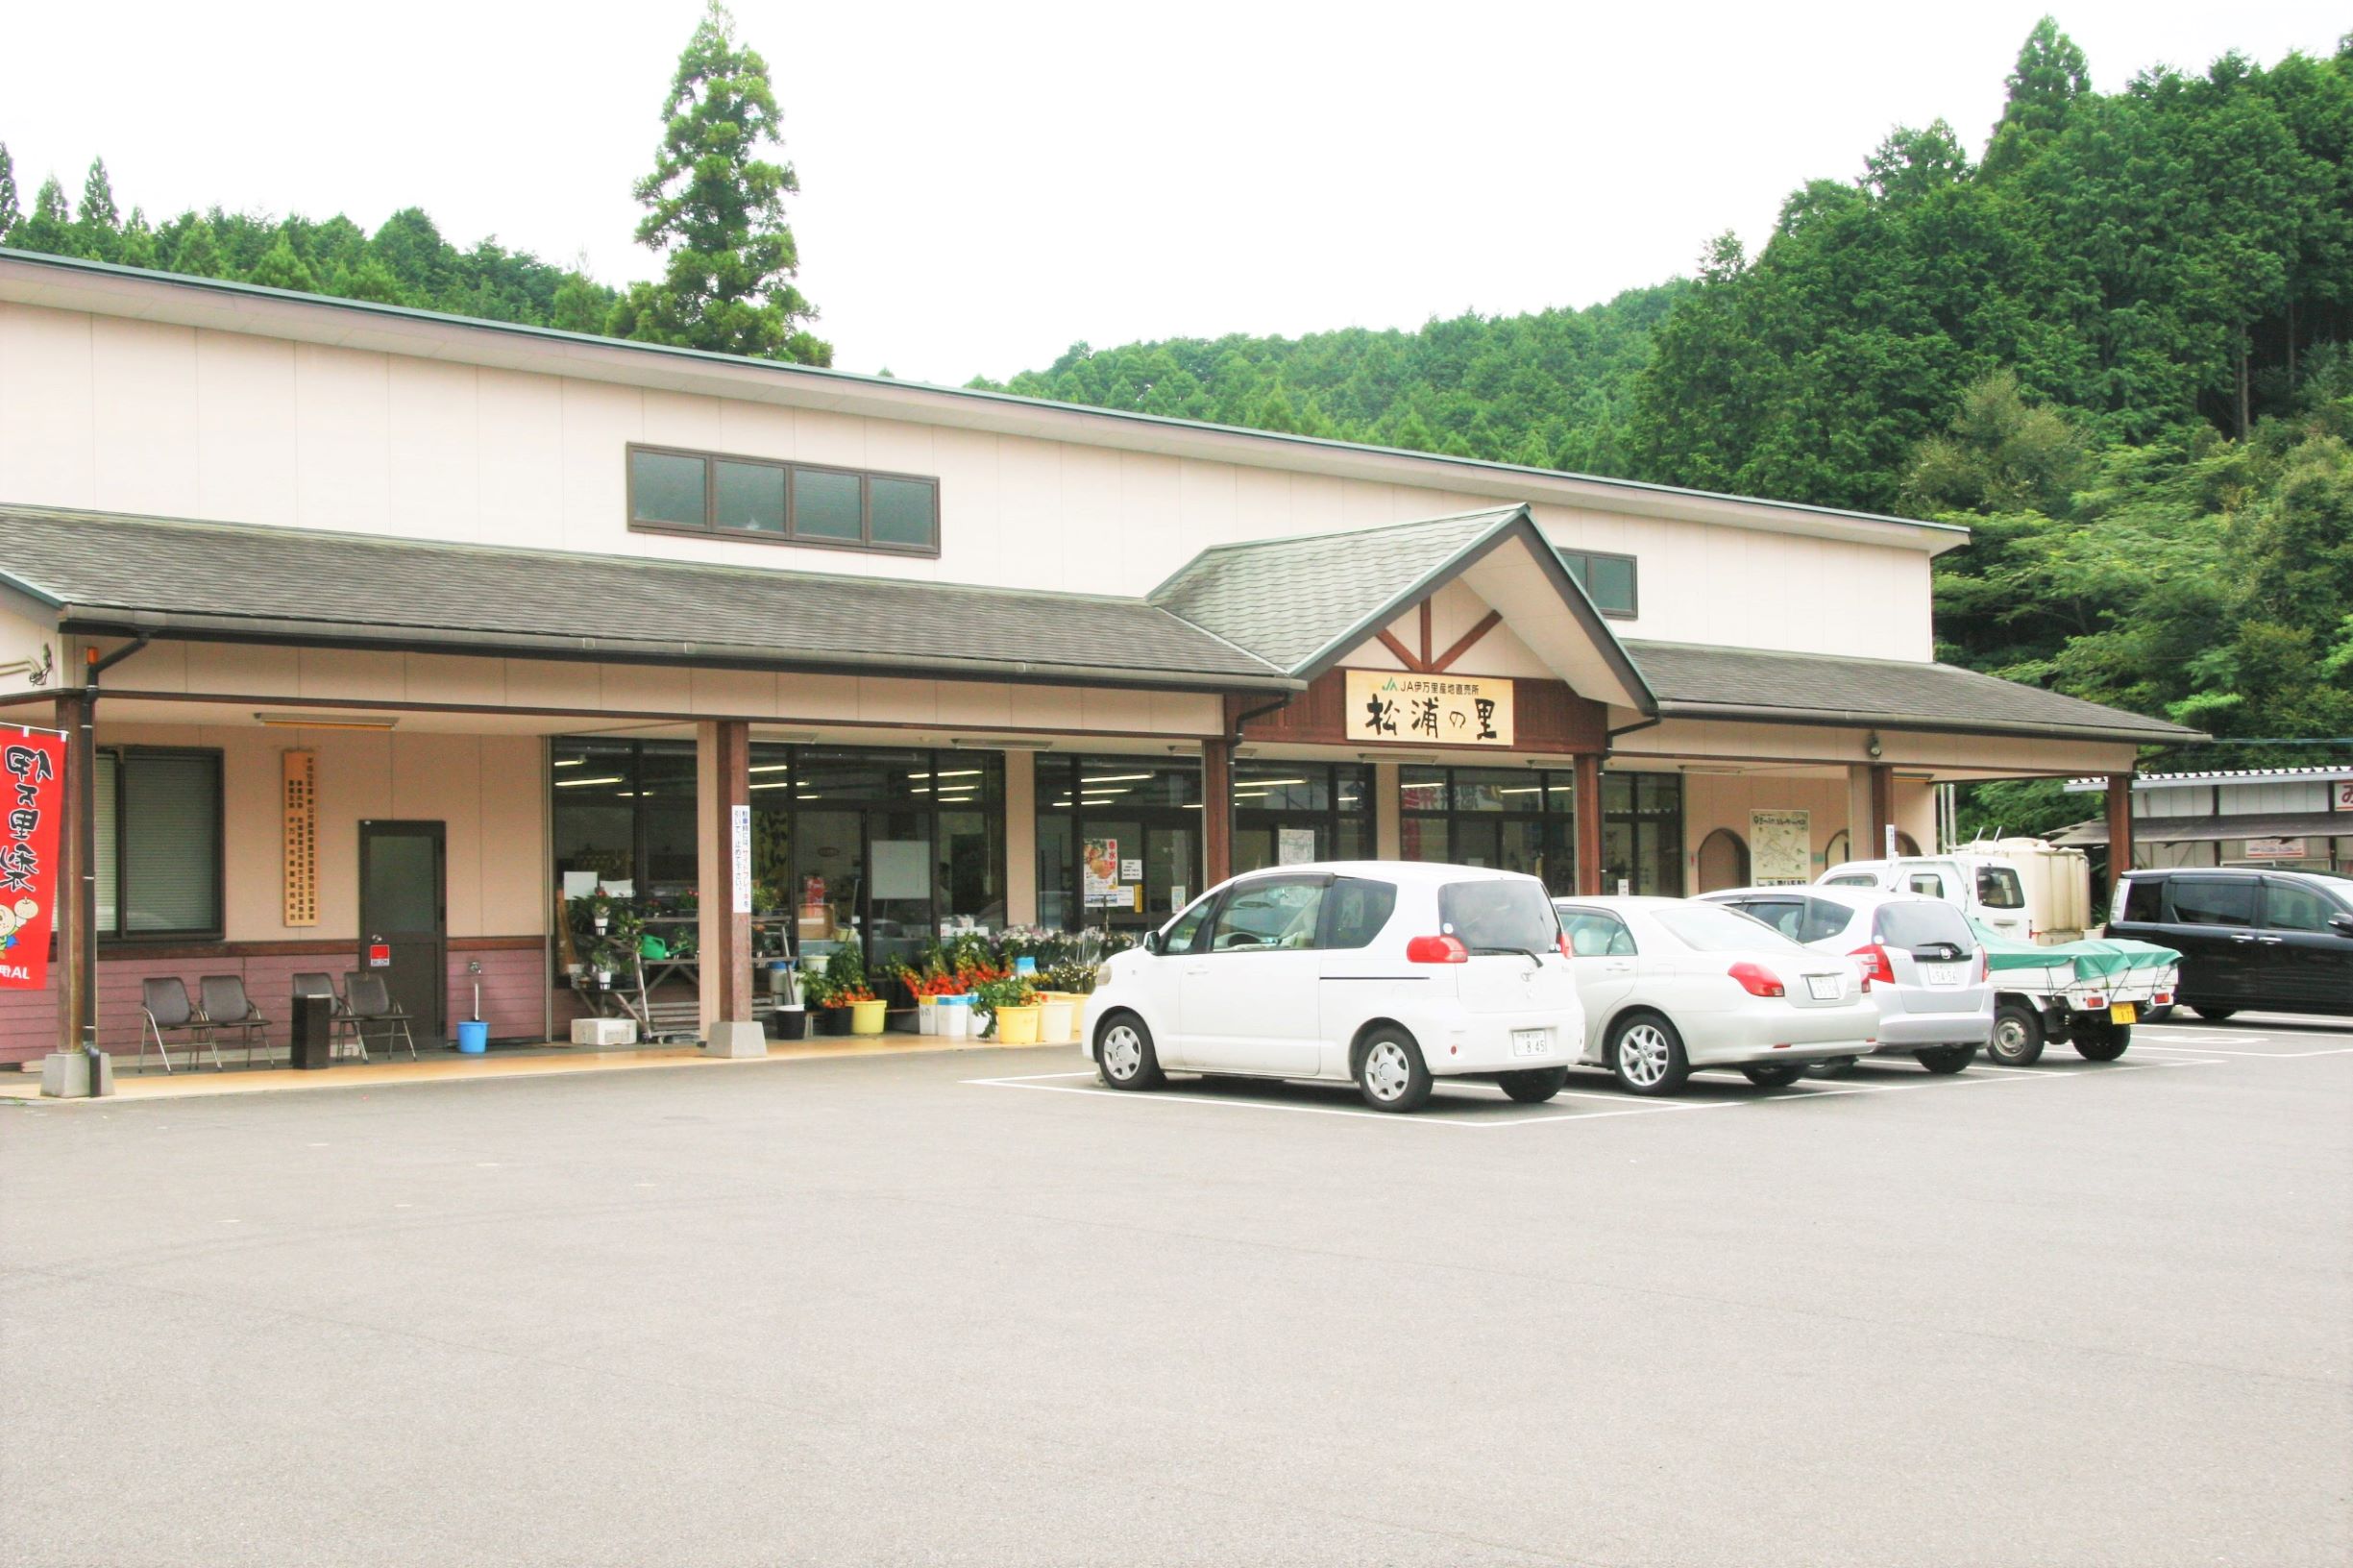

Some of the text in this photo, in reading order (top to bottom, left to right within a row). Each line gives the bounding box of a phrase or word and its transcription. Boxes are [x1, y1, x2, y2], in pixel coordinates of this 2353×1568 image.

[1401, 681, 1480, 696] JA伊万里産地直売所
[1365, 693, 1497, 741] 松浦の里
